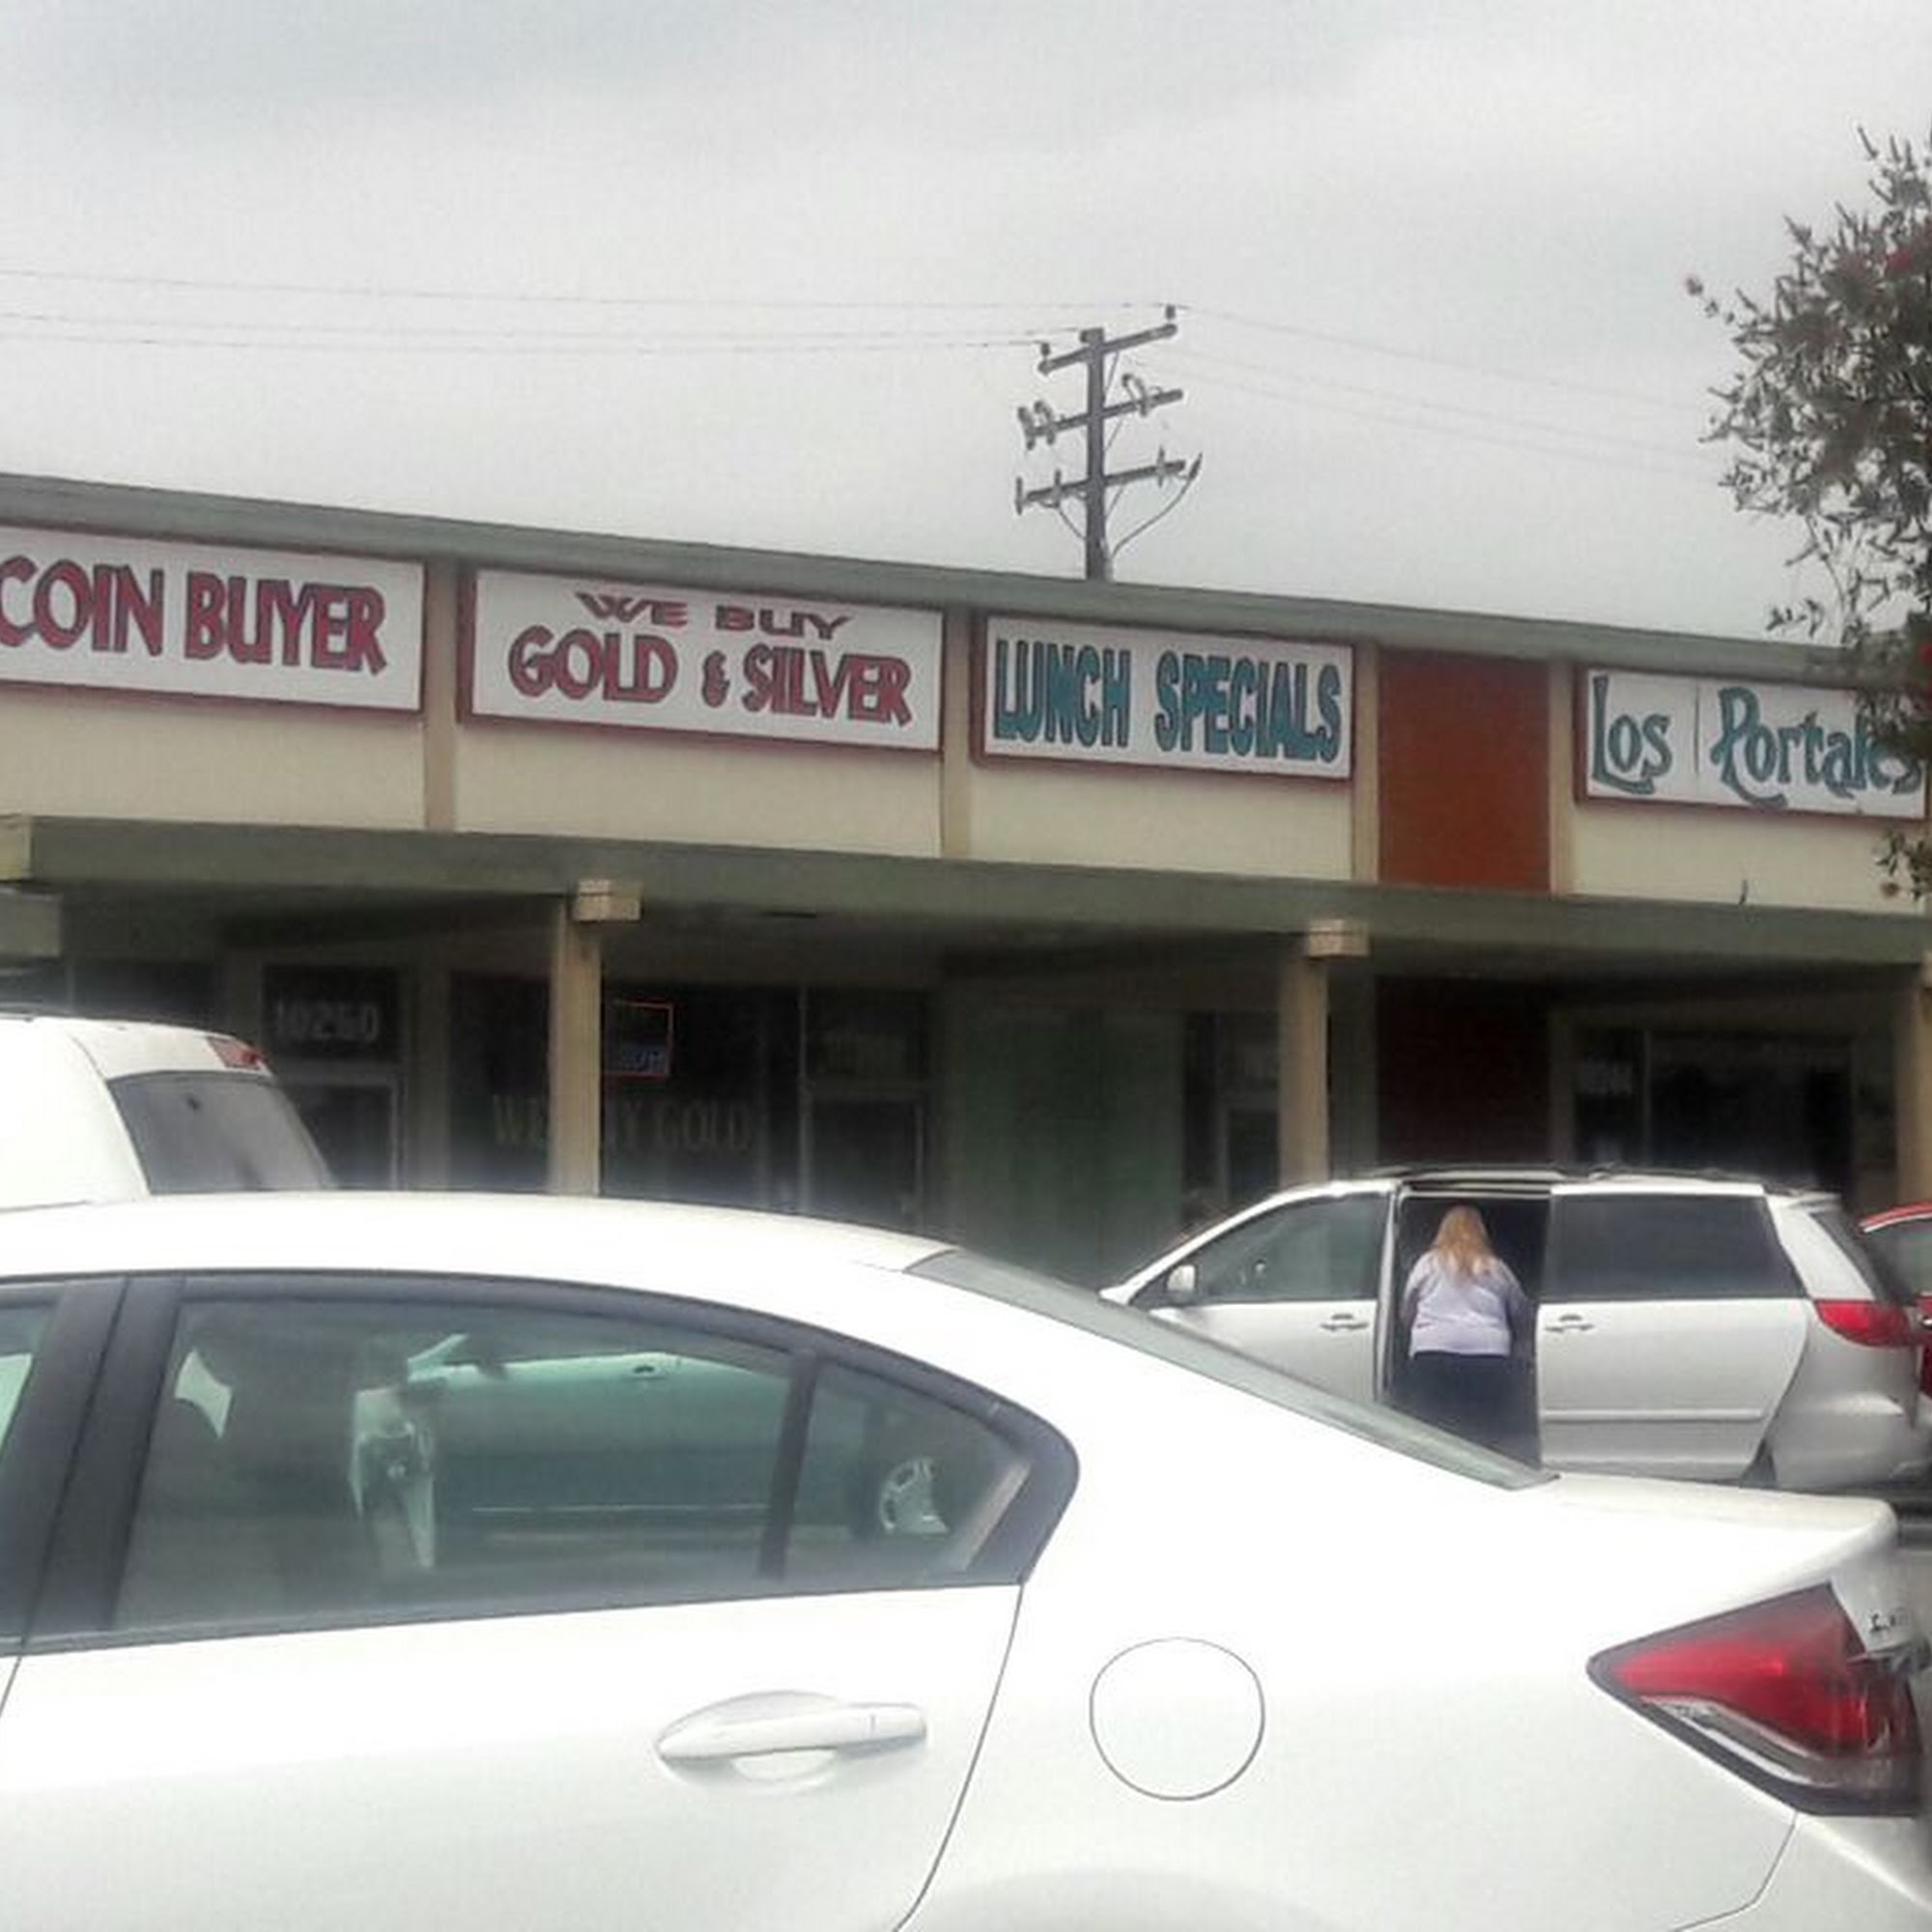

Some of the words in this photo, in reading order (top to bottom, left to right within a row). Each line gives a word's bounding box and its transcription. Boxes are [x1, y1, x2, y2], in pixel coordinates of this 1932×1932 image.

[0, 554, 163, 656] COIN
[185, 571, 386, 674] BUYER
[576, 592, 689, 627] WE
[715, 605, 856, 640] BUY
[508, 625, 679, 703] GOLD
[701, 649, 733, 709] &
[742, 642, 912, 727] SILVER
[993, 639, 1132, 748] LUNCH
[1154, 650, 1343, 764] SPECIALS
[1591, 675, 1673, 795] Los
